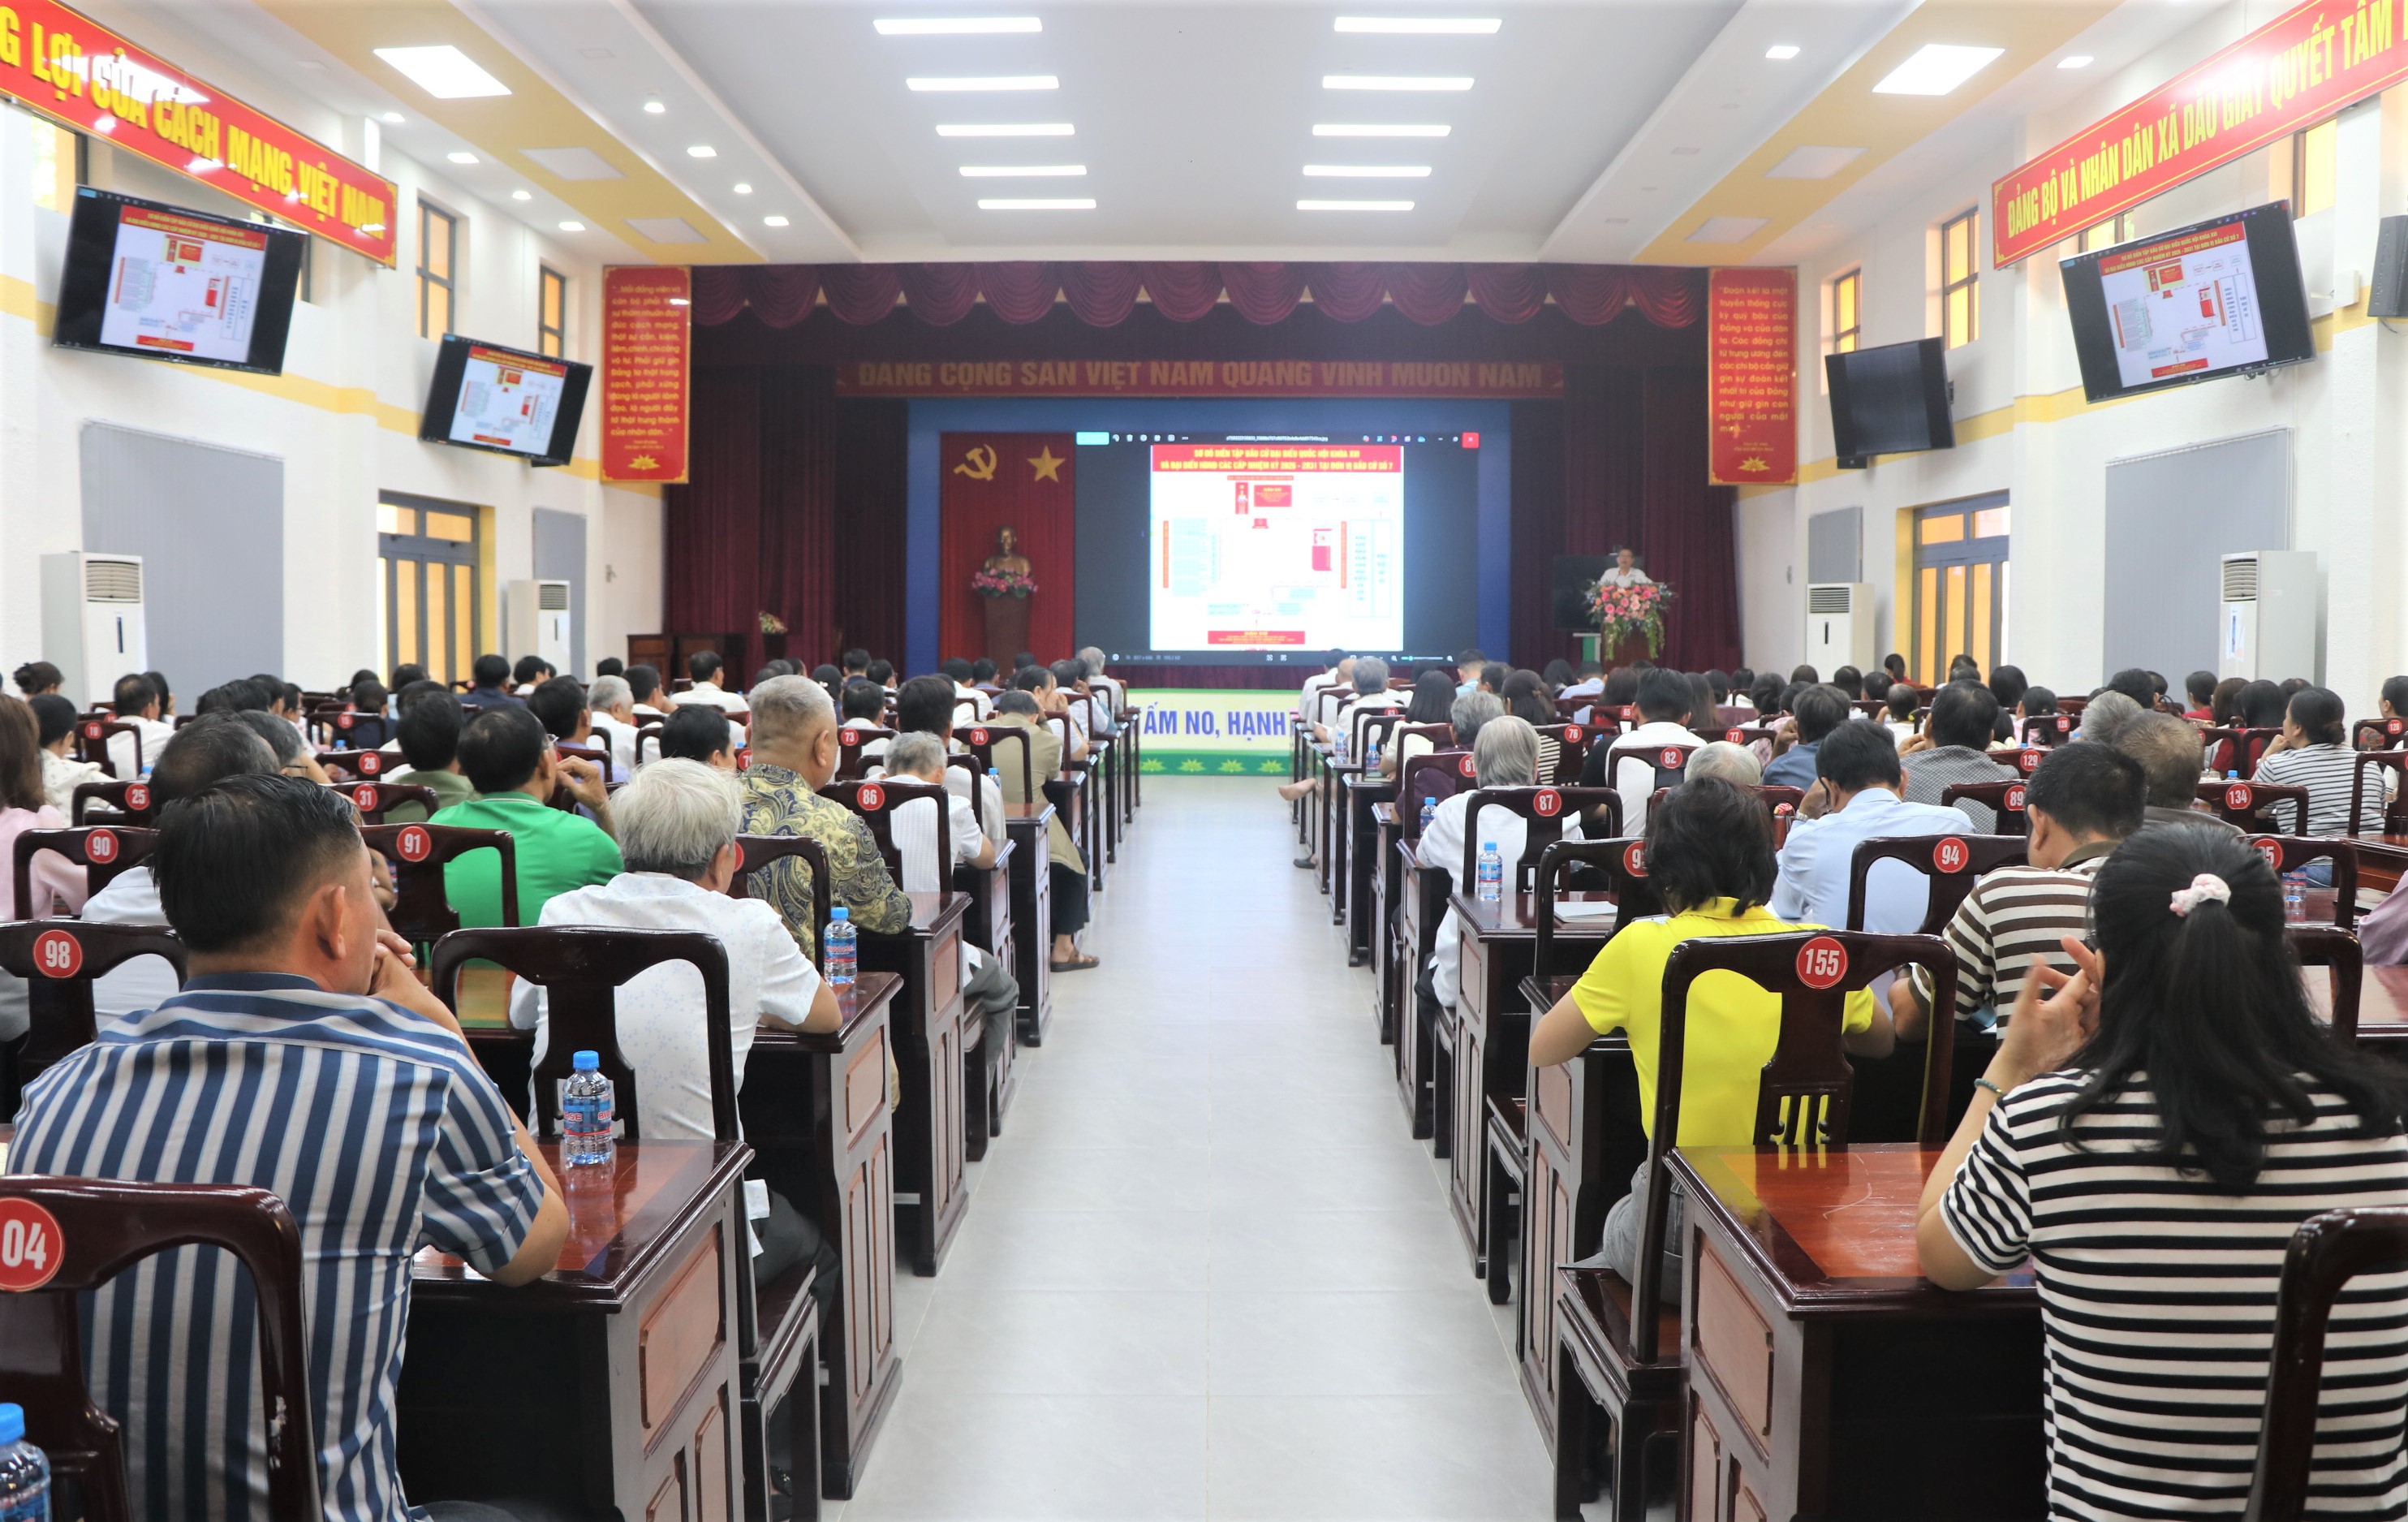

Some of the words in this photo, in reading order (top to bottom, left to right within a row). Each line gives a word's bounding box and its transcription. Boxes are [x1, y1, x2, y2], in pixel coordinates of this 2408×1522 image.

[31, 22, 82, 101] LỢI
[227, 124, 292, 196] MẠNG
[298, 162, 338, 222] VIỆT
[342, 183, 385, 239] NAM
[2008, 183, 2039, 238] ĐẢNG
[2042, 169, 2058, 225] BỘ
[2061, 158, 2078, 211] VÀ
[2080, 140, 2119, 201] NHÂN
[2122, 123, 2154, 181] DÂN
[2157, 102, 2180, 164] XÃ
[2270, 13, 2336, 110] QUYẾT
[1149, 361, 1214, 386] NAM
[1222, 361, 1312, 388] QUANG
[1320, 362, 1383, 386] VINH
[1144, 701, 1178, 735] ẤM
[1186, 710, 1220, 738] NO,
[1228, 711, 1286, 741] HẠNH
[845, 731, 855, 742] 73
[975, 731, 984, 742] 74
[1569, 729, 1579, 739] 76
[1730, 731, 1739, 742] 77
[364, 757, 377, 770] 26
[1665, 751, 1677, 765] 82
[2023, 755, 2038, 766] 129
[131, 789, 145, 804] 25
[360, 791, 372, 806] 31
[862, 789, 877, 804] 86
[1539, 795, 1553, 811] 87
[2010, 791, 2024, 805] 89
[2229, 790, 2248, 804] 134
[93, 836, 110, 856] 90
[404, 834, 420, 854] 91
[1941, 845, 1960, 865] 94
[45, 939, 71, 968] 98
[1805, 947, 1839, 977] 155
